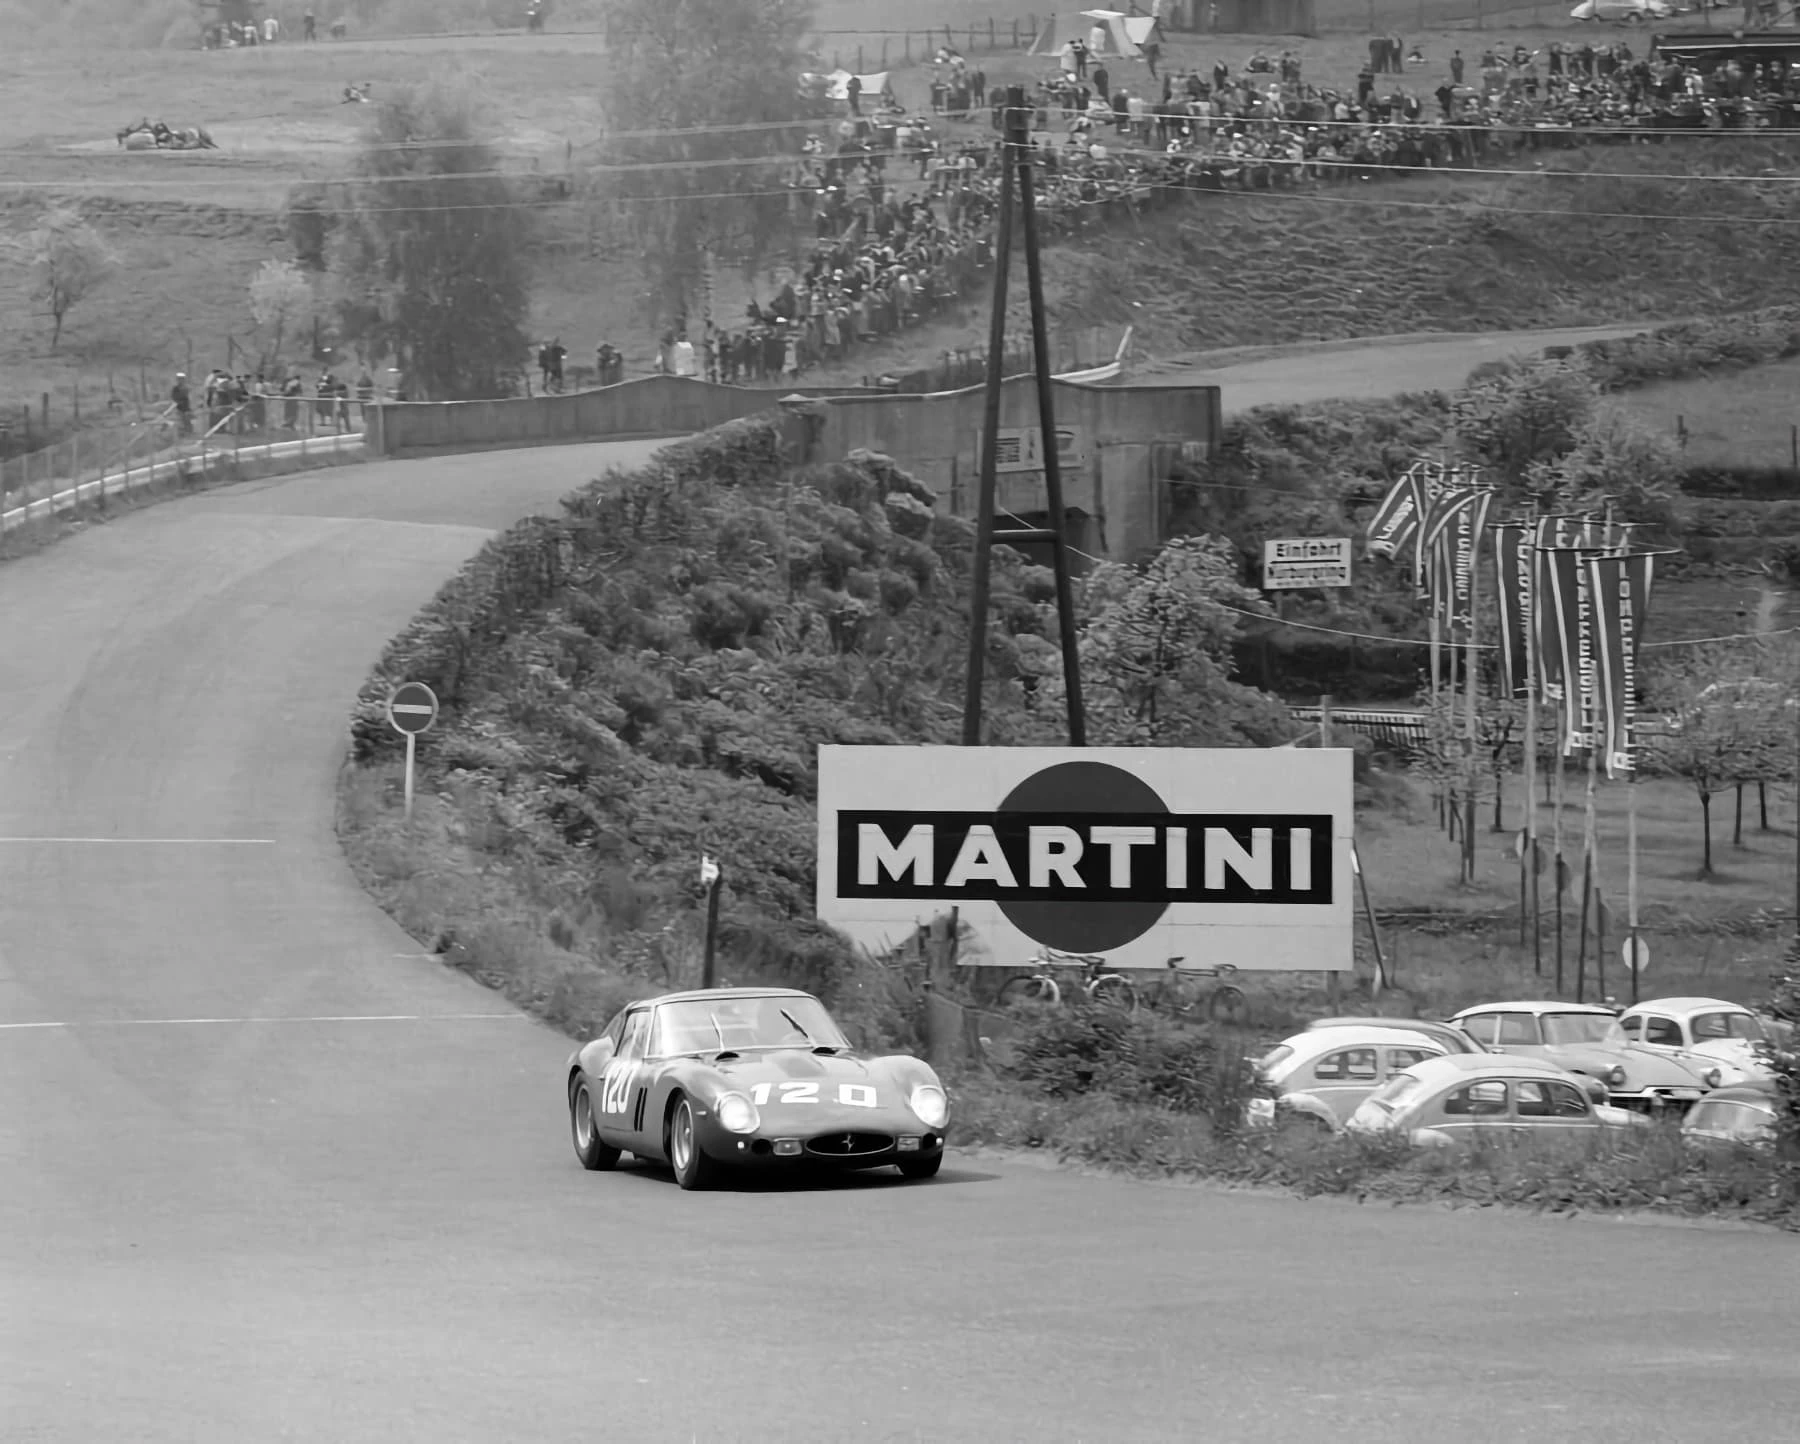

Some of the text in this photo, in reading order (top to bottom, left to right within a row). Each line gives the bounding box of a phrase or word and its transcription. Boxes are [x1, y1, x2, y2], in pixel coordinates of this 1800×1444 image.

[857, 823, 1311, 891] MARTINI
[602, 1065, 634, 1114] 120
[749, 1081, 877, 1108] 120
